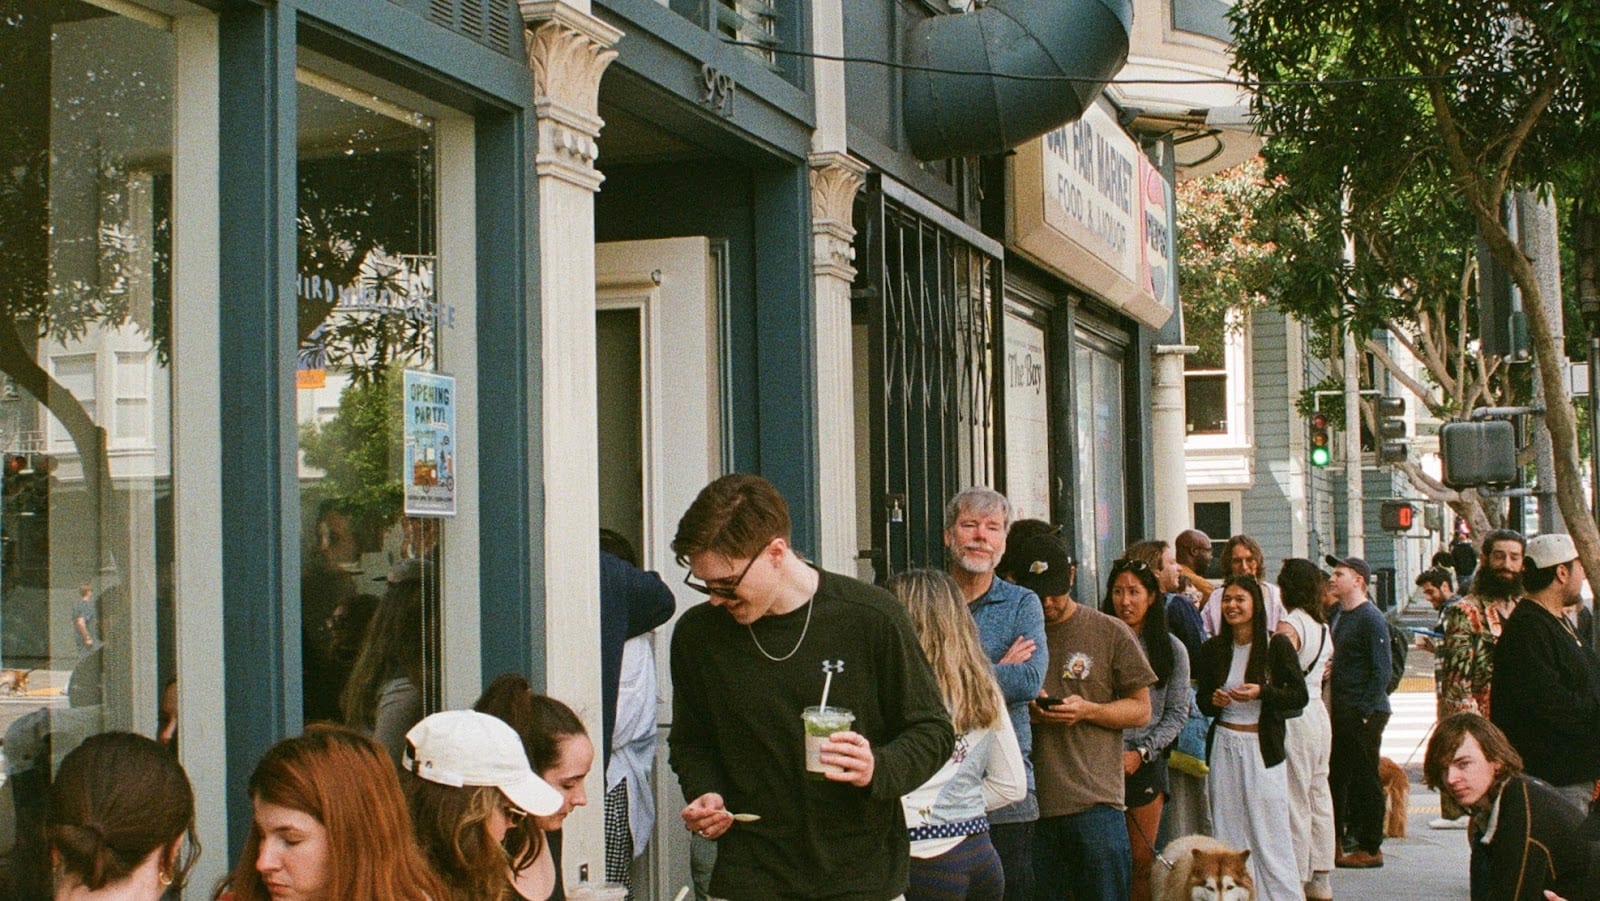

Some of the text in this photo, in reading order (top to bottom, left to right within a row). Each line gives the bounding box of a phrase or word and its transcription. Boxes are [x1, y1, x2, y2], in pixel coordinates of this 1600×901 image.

[1073, 118, 1095, 187] FAIR
[1097, 133, 1132, 218] MARKET
[1058, 172, 1083, 222] FOOD
[1008, 352, 1024, 389] The
[410, 383, 450, 406] OPENING
